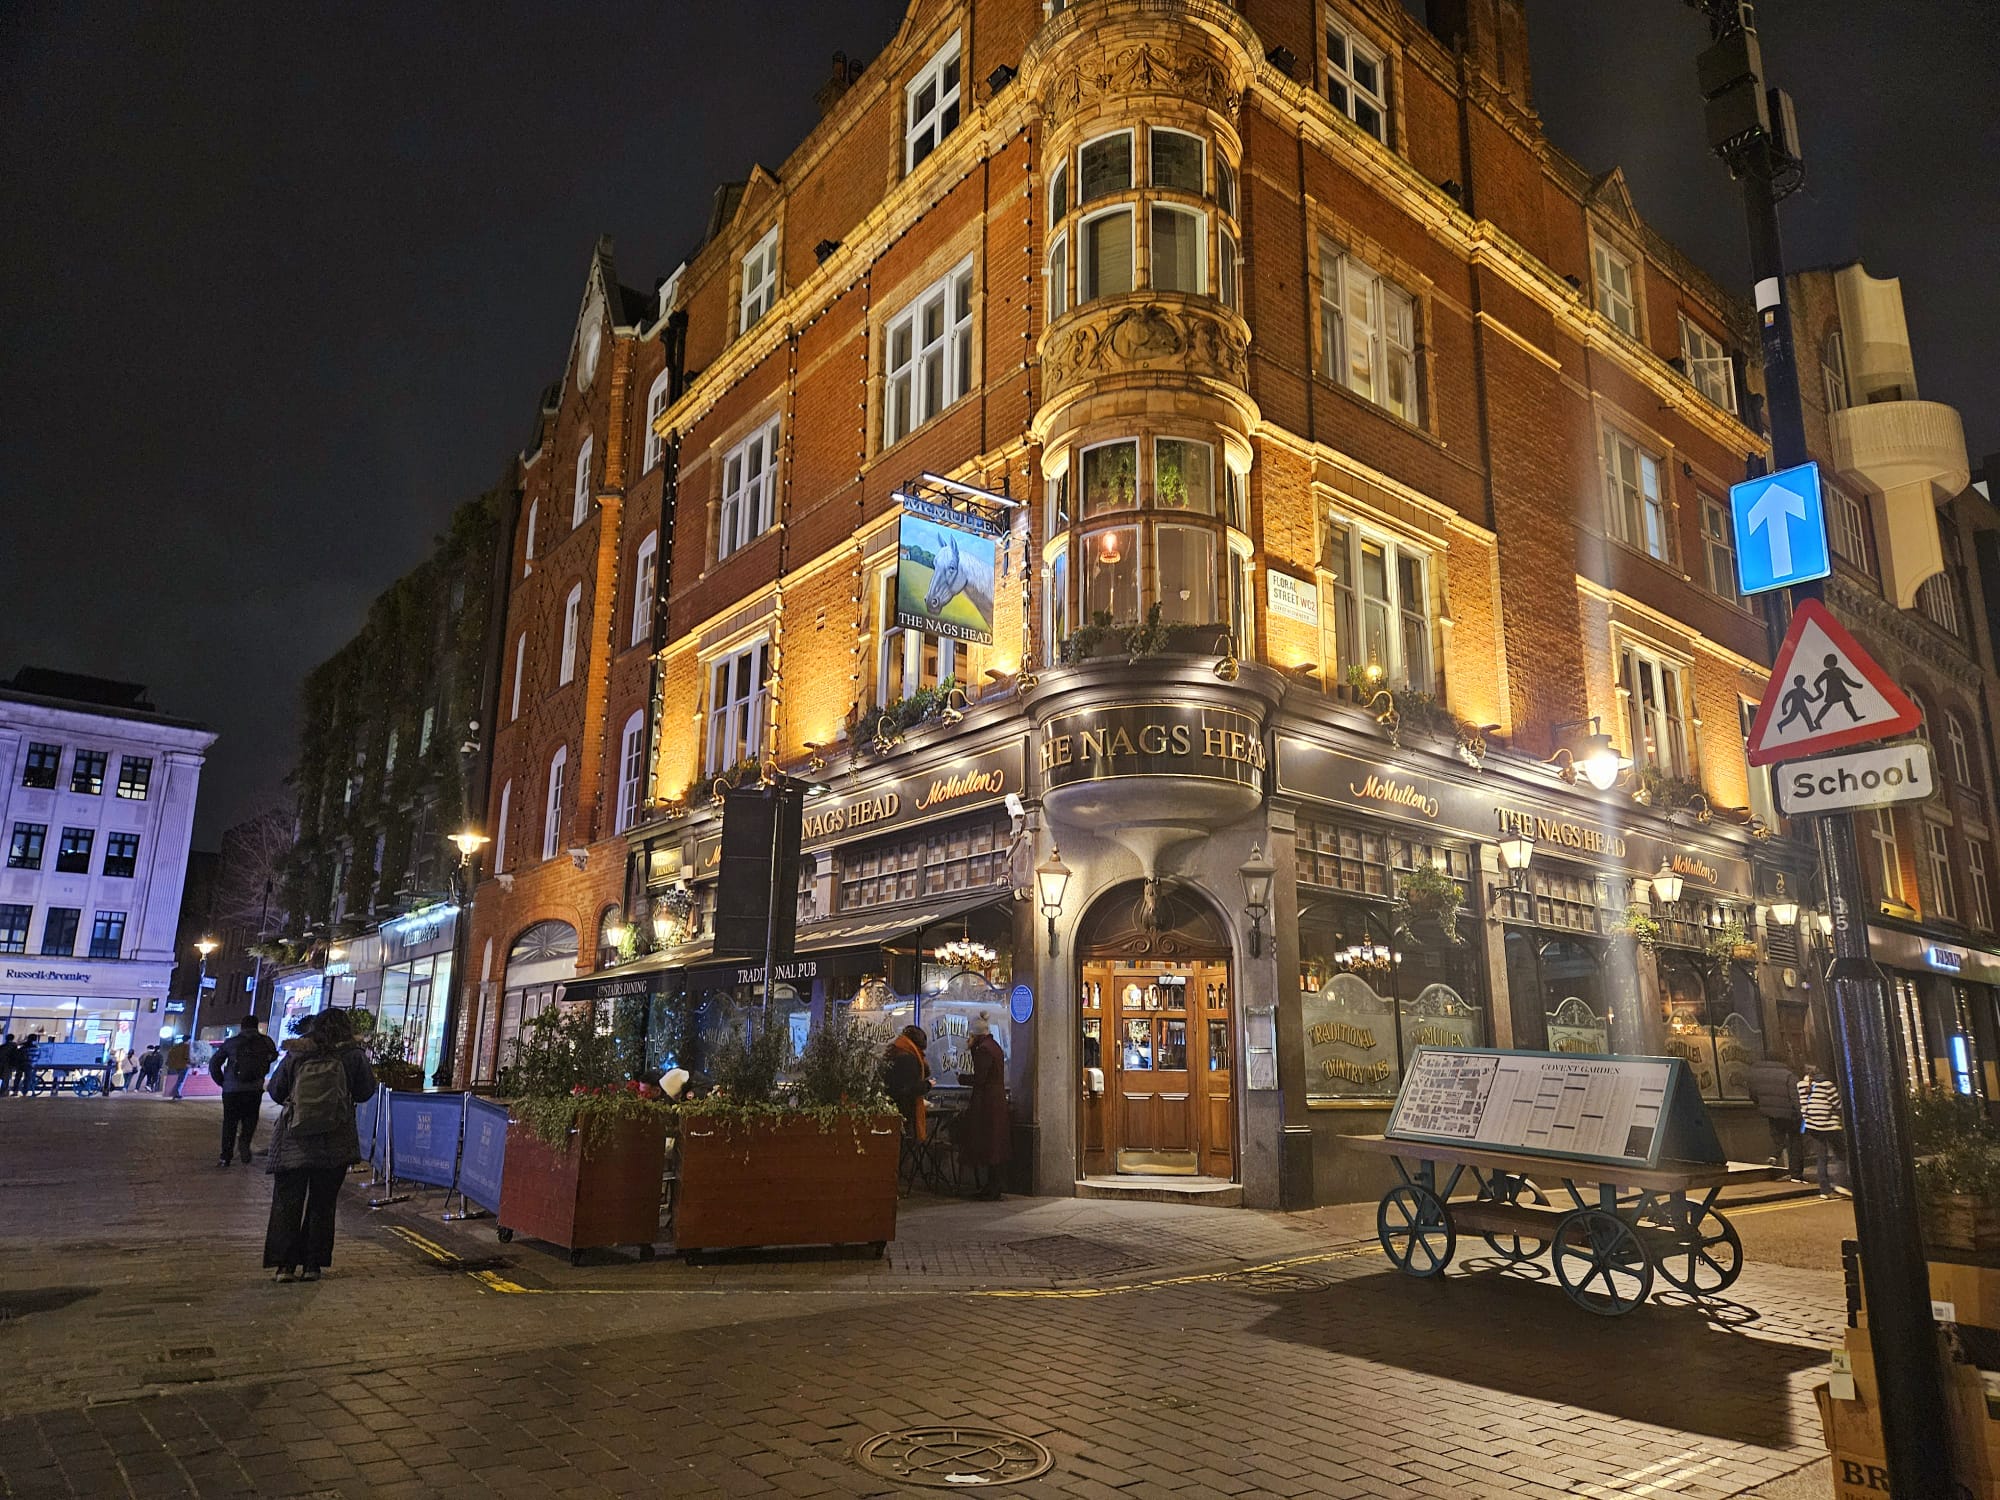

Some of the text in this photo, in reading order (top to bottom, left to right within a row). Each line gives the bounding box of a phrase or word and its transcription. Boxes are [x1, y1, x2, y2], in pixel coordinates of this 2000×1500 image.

[1273, 575, 1297, 593] FLORAL
[1273, 588, 1316, 611] STREET WC2
[899, 612, 993, 645] THE NAGS HEAD
[1080, 725, 1191, 760] NAGS
[1202, 727, 1266, 772] HEAD
[916, 769, 1004, 810] McMullen
[1793, 758, 1918, 798] School
[1351, 775, 1439, 817] McMullen
[801, 792, 899, 840] NAGS HEAD
[1494, 806, 1627, 858] THE NAGS HEAD
[1671, 854, 1718, 884] McMullen
[798, 961, 817, 977] PUB
[623, 980, 647, 995] DINING
[1307, 1022, 1377, 1050] TRADITIONAL
[1322, 1058, 1364, 1084] COUNTRY
[1541, 1063, 1621, 1075] COVENT GARDEN
